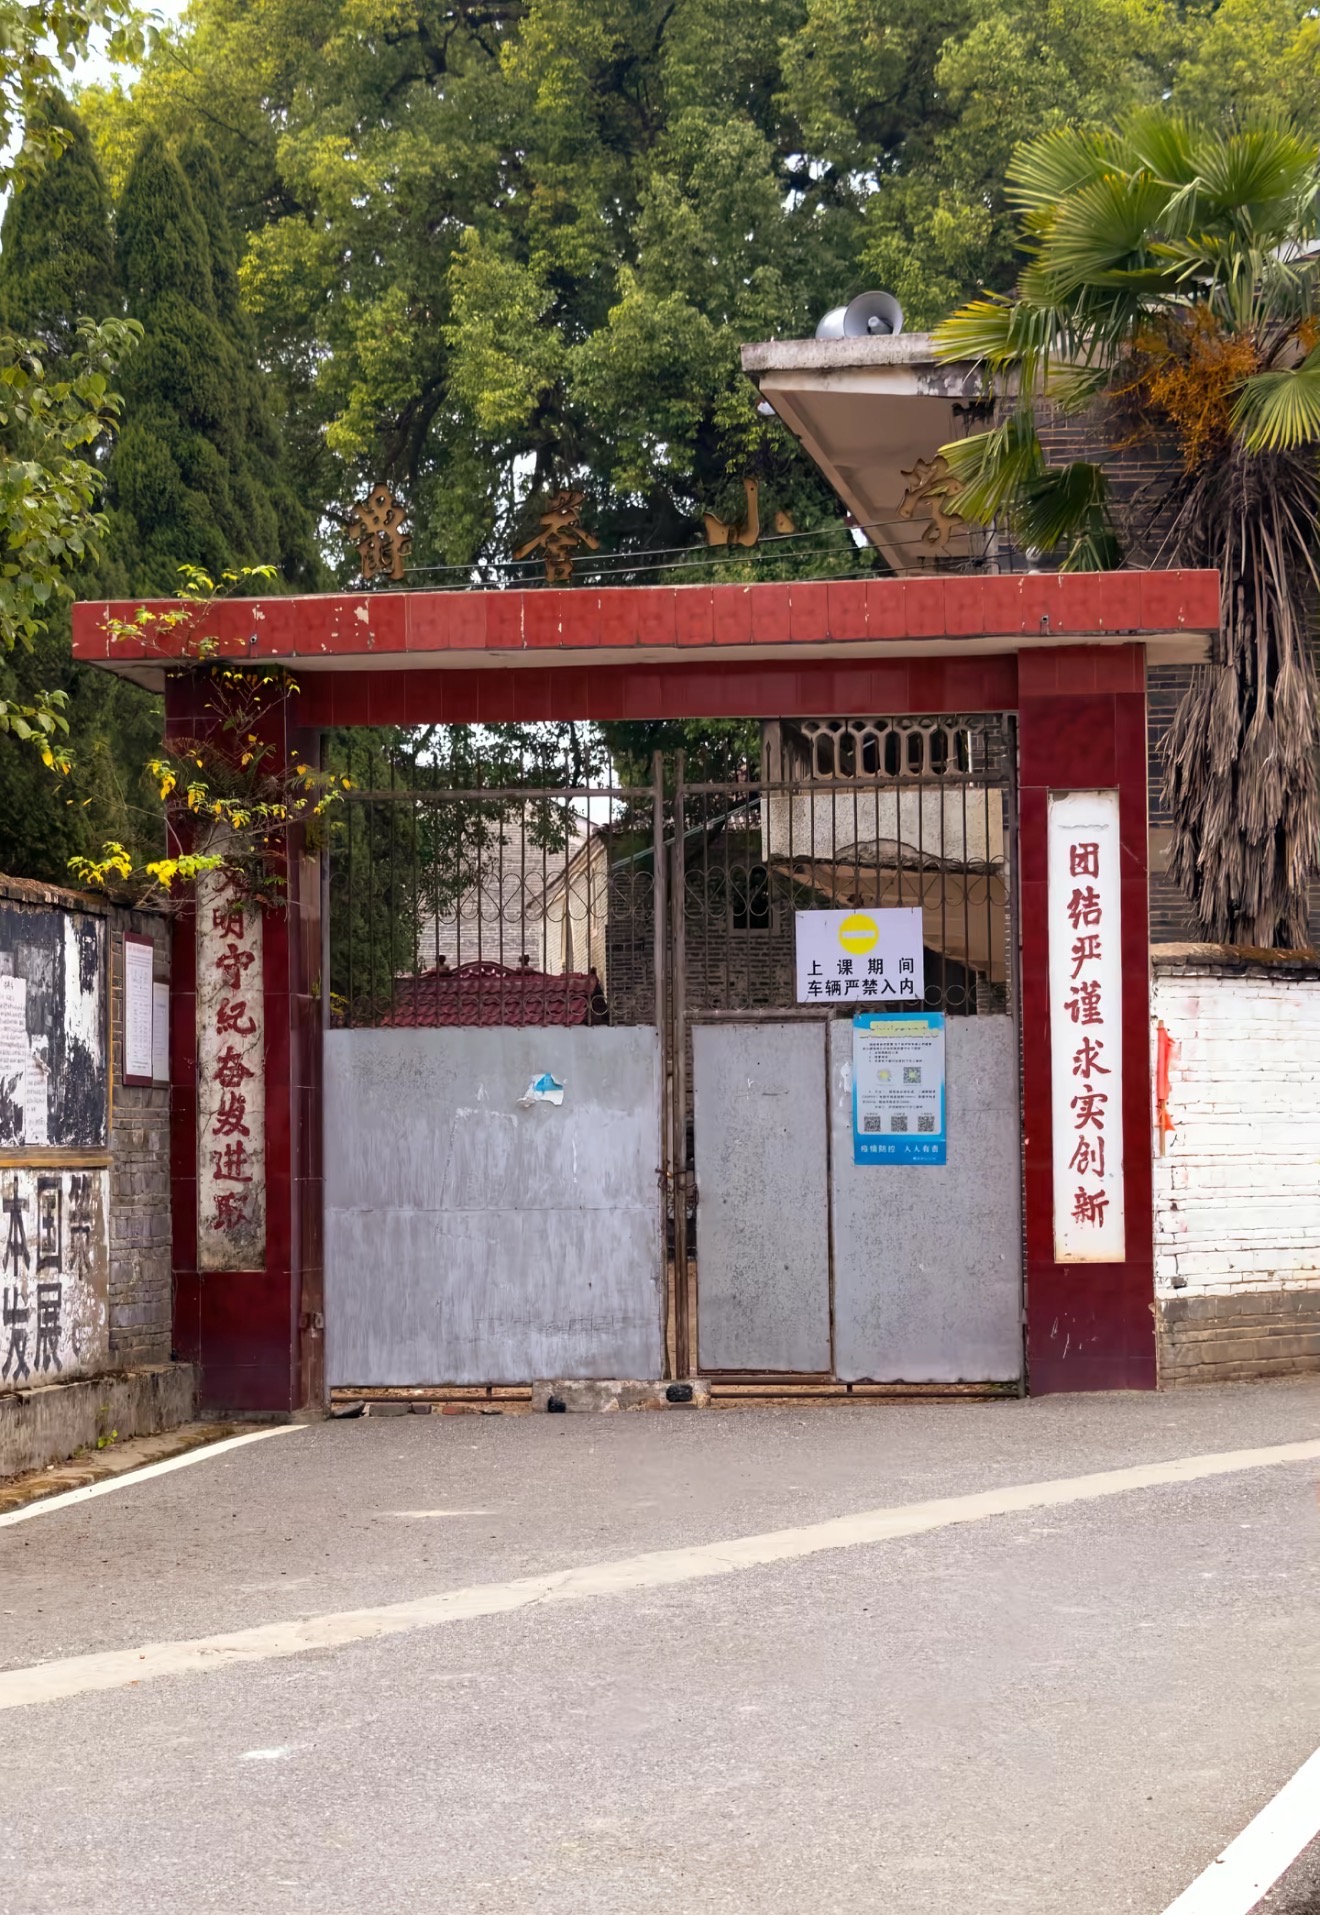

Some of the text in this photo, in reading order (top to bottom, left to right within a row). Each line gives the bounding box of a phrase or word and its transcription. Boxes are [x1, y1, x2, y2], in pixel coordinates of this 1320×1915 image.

[807, 957, 914, 976] 上课期间
[807, 978, 914, 997] 车辆严禁入内
[1064, 842, 1110, 1229] 团结严谨求实创新
